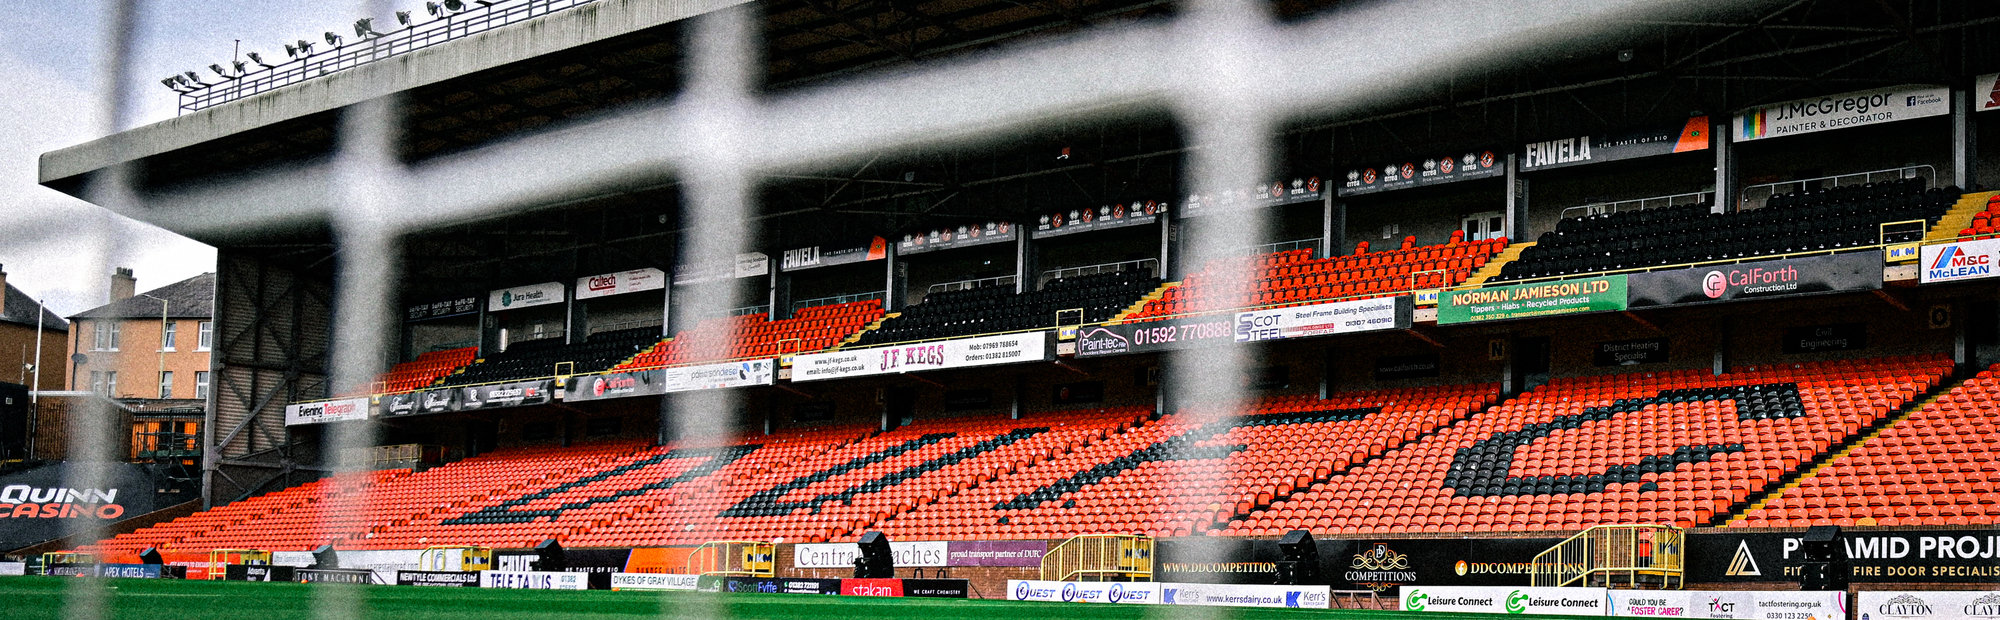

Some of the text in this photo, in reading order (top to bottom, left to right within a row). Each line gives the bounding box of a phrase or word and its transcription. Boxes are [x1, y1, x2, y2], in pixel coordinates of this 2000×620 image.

[1776, 92, 1893, 121] J.McGregor
[1776, 111, 1893, 134] PAINTER & DECORATOR
[1616, 138, 1637, 146] TASTE
[1525, 136, 1591, 167] FAVELA
[783, 246, 820, 269] FAVELA
[1952, 254, 1990, 267] M&C
[1729, 265, 1798, 286] CalForth
[1929, 265, 1990, 279] McLEAN
[1453, 280, 1609, 306] NORMAN JAMIESON LTD
[1744, 282, 1797, 294] Construction Ltd
[513, 289, 543, 302] Jura Health
[1470, 296, 1590, 314] Tippers Hiabs Recycled Products
[1295, 304, 1393, 319] Steel Frame Building Specialists
[1239, 314, 1282, 330] SCOT
[1134, 321, 1232, 345] 01592 770888
[1237, 327, 1286, 342] STEEL
[969, 343, 982, 351] Mob:
[1082, 338, 1119, 350] Paint-tec
[1603, 340, 1660, 353] District Heating
[814, 355, 857, 365] www.jf-kegs.co.uk
[905, 345, 945, 366] KEGS
[965, 353, 985, 361] Orders:
[1614, 351, 1647, 363] Specialist
[821, 364, 865, 374] info@jf-kegs.co.uk
[298, 404, 323, 417] Evening
[0, 484, 118, 504] QUINN
[0, 502, 125, 519] CASINO
[1783, 537, 1910, 559] PAMID
[800, 545, 941, 566] Centra aches
[950, 549, 1042, 560] proud transport partner of DUFC
[104, 567, 119, 577] APEX
[122, 567, 144, 578] HOTELS
[1162, 562, 1279, 573] WWW.DDCOMPETITION
[1853, 566, 1881, 576] FIRE
[1887, 566, 1926, 576] DOOR
[1932, 565, 2000, 576] SPECIALIS
[296, 572, 370, 584] TONY MACARONI
[400, 572, 477, 583] NEWTYLE COMMERCIALS Ltd
[490, 573, 552, 590] TELE TAXIS
[613, 575, 696, 587] DYKES OF GRAY VILLAGE
[1345, 571, 1417, 582] COMPETITIONS
[852, 580, 892, 597] stakam
[1016, 581, 1056, 600] QUEST
[1061, 583, 1102, 602] QUEST
[1108, 583, 1151, 603] QUEST
[1180, 589, 1200, 598] Kerr's
[1206, 594, 1283, 606] www.kerrsdairy.co.uk
[1303, 591, 1326, 601] Kerr's
[1428, 597, 1493, 606] Leisure Connect
[1628, 598, 1667, 606] COULD YOU BE
[1528, 597, 1599, 608] Leisure Connect
[1708, 602, 1735, 613] TACT
[1758, 600, 1822, 609] tactfostering.org.uk
[1631, 606, 1656, 615] FOSTER
[1658, 606, 1684, 617] CARER?
[1766, 612, 1813, 620] 0330 123 2250
[1879, 604, 1933, 616] CLAYTON
